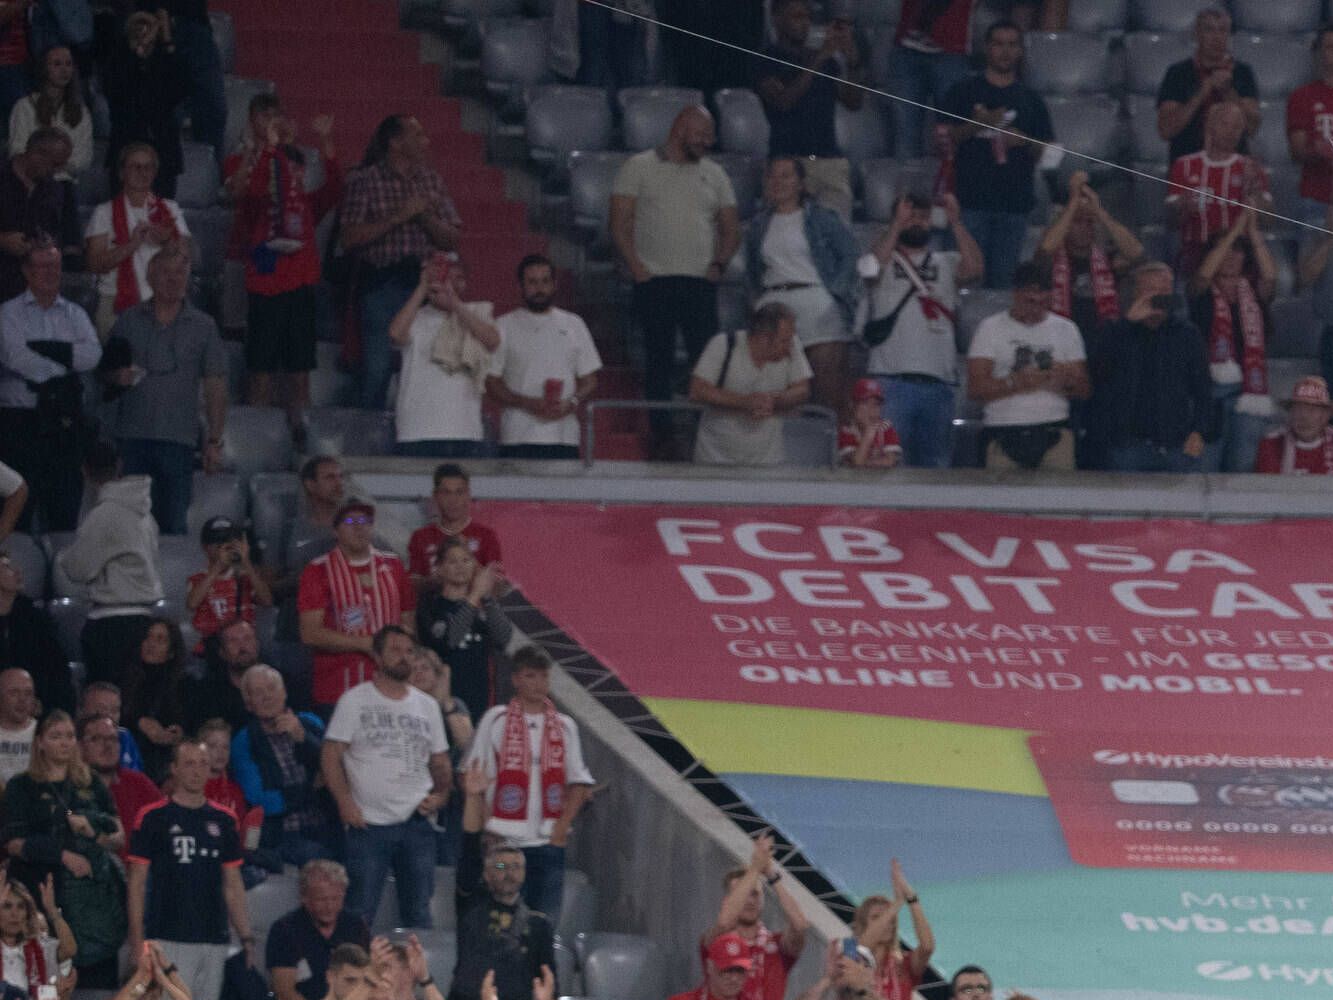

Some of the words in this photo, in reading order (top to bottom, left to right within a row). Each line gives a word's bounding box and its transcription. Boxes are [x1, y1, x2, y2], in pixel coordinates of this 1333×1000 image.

[656, 518, 905, 564] FCB
[936, 533, 1256, 574] VISA
[679, 565, 1062, 614] DEBIT
[711, 614, 801, 635] DIE
[809, 617, 1119, 645] BANKKARTE
[1131, 626, 1236, 648] FÜR
[728, 639, 1071, 665] GELEGENHEIT
[1124, 650, 1190, 669] IM
[739, 665, 955, 687] ONLINE
[967, 671, 1084, 691] UND
[1099, 674, 1304, 696] MOBIL.
[1179, 891, 1312, 912] Mehr
